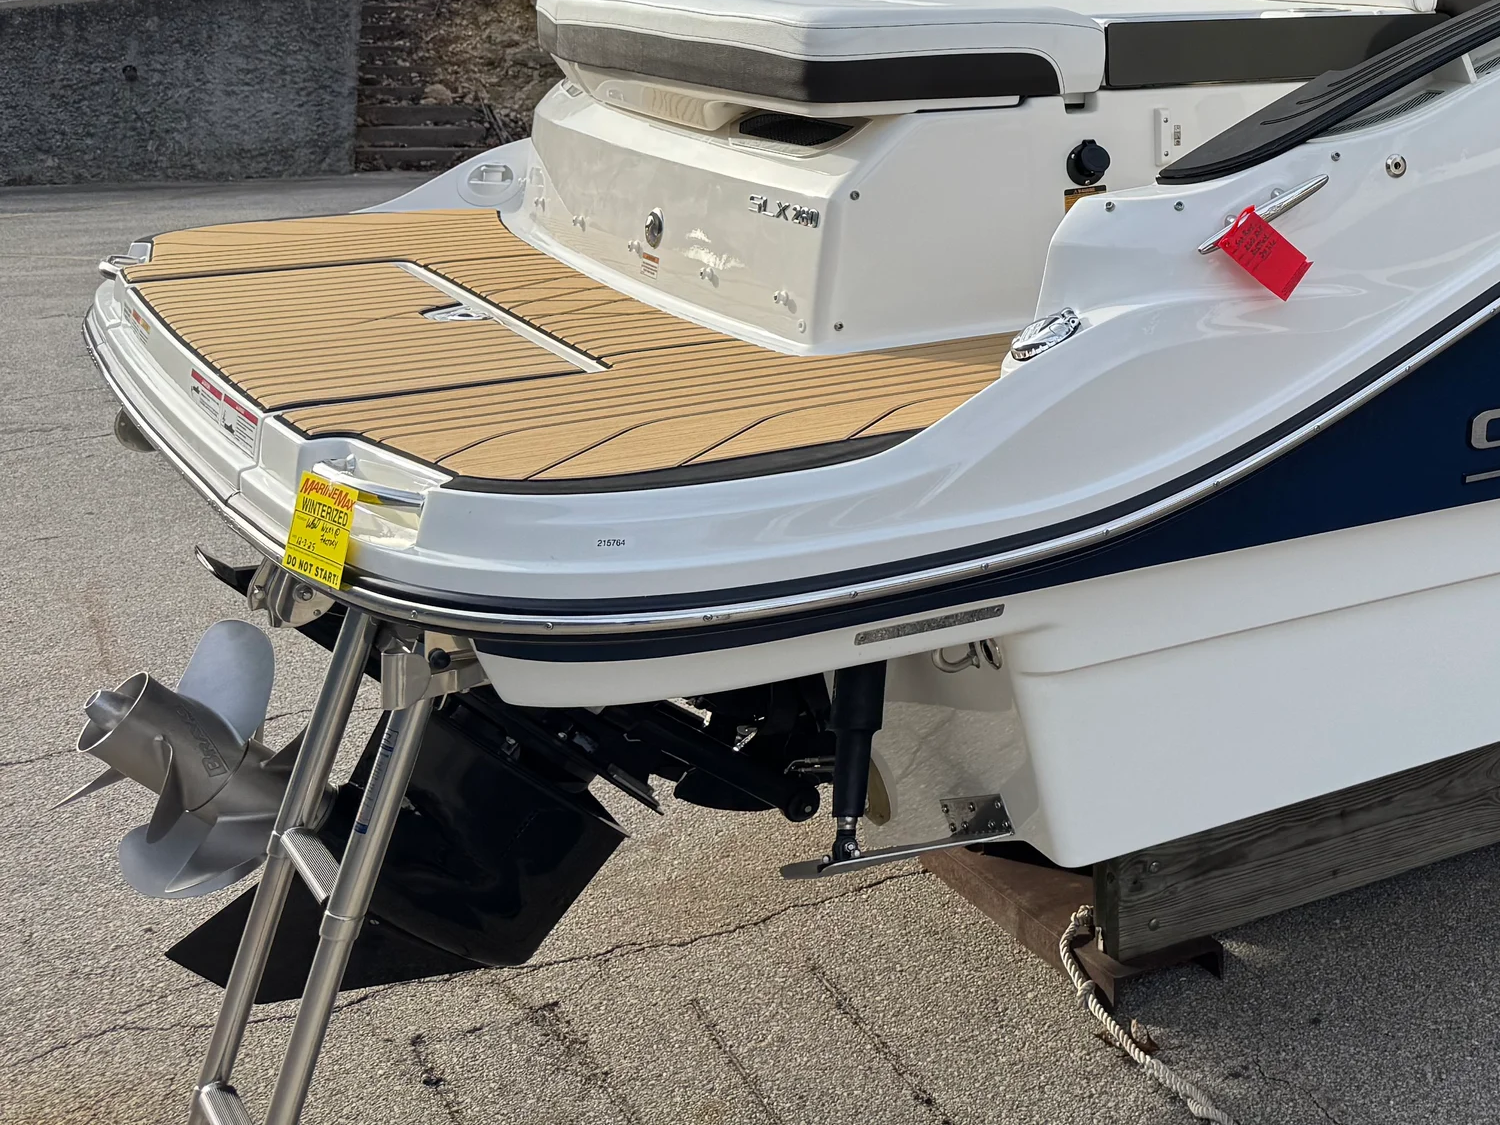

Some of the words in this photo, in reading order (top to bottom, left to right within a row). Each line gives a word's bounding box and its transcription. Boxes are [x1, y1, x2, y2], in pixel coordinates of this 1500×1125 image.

[748, 193, 790, 222] SLX
[301, 496, 349, 527] WINTERIZED
[597, 538, 626, 547] 215764
[286, 554, 297, 567] DO
[299, 560, 313, 574] NOT
[314, 565, 340, 586] START!
